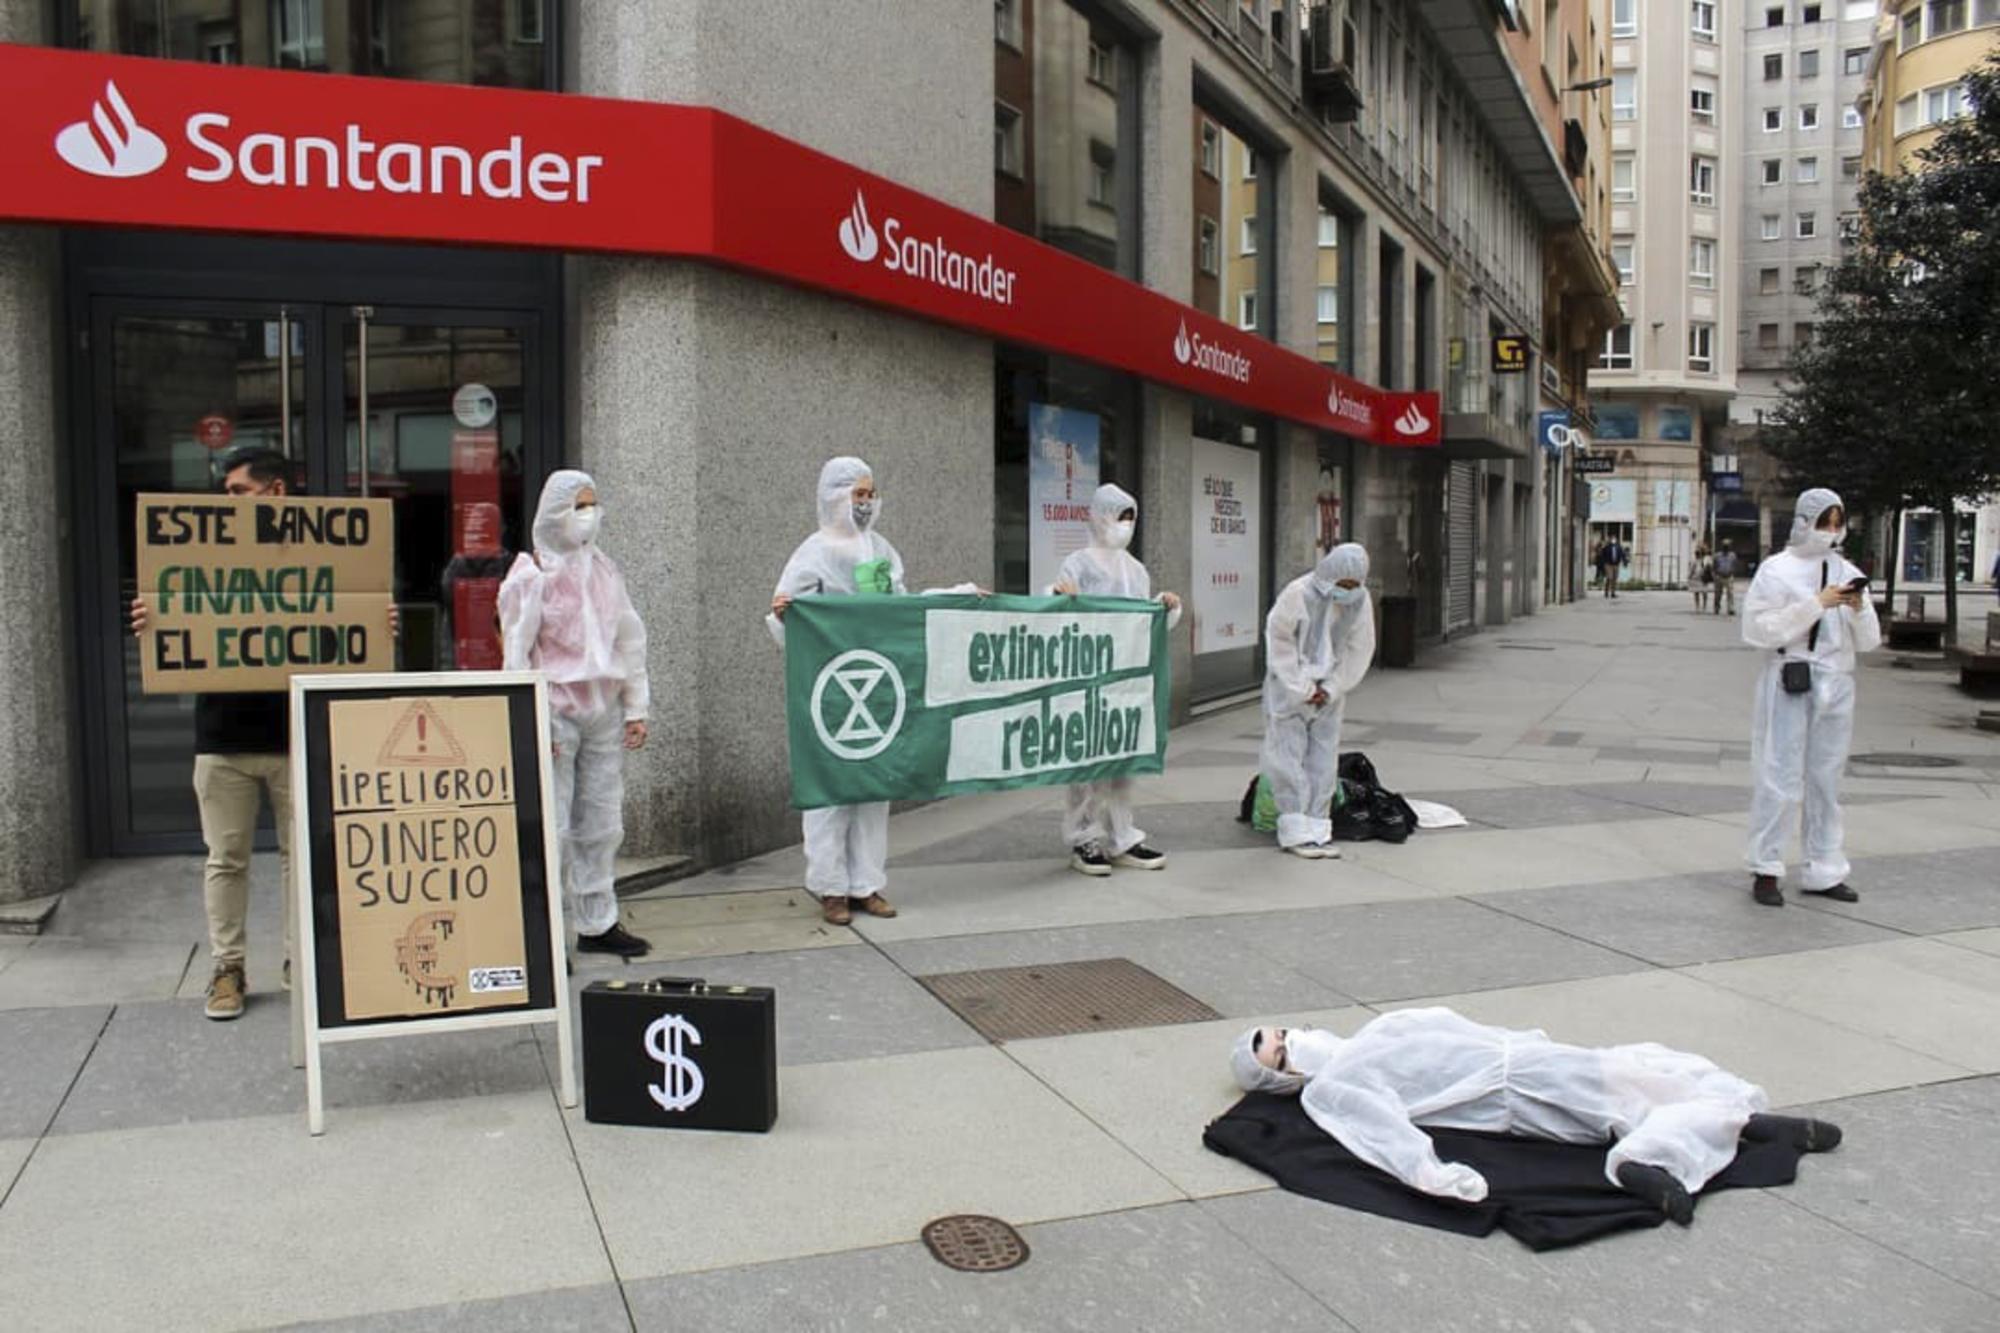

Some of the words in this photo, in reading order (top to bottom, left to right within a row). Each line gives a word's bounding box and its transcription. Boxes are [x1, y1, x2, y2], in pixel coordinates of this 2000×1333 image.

[185, 111, 603, 204] Santander
[883, 215, 1017, 306] Santander
[1192, 332, 1251, 383] Santander
[146, 505, 237, 545] ESTE
[256, 504, 369, 546] BANCO
[158, 565, 334, 614] FINANCIA
[156, 629, 207, 671] EL
[216, 625, 367, 668] ECOCIDIO
[968, 622, 1114, 683] extinction
[1002, 686, 1142, 770] rebellion
[340, 764, 509, 806] ¡PELIGRO!
[346, 816, 497, 869] DINERO
[355, 864, 488, 907] SUCIO
